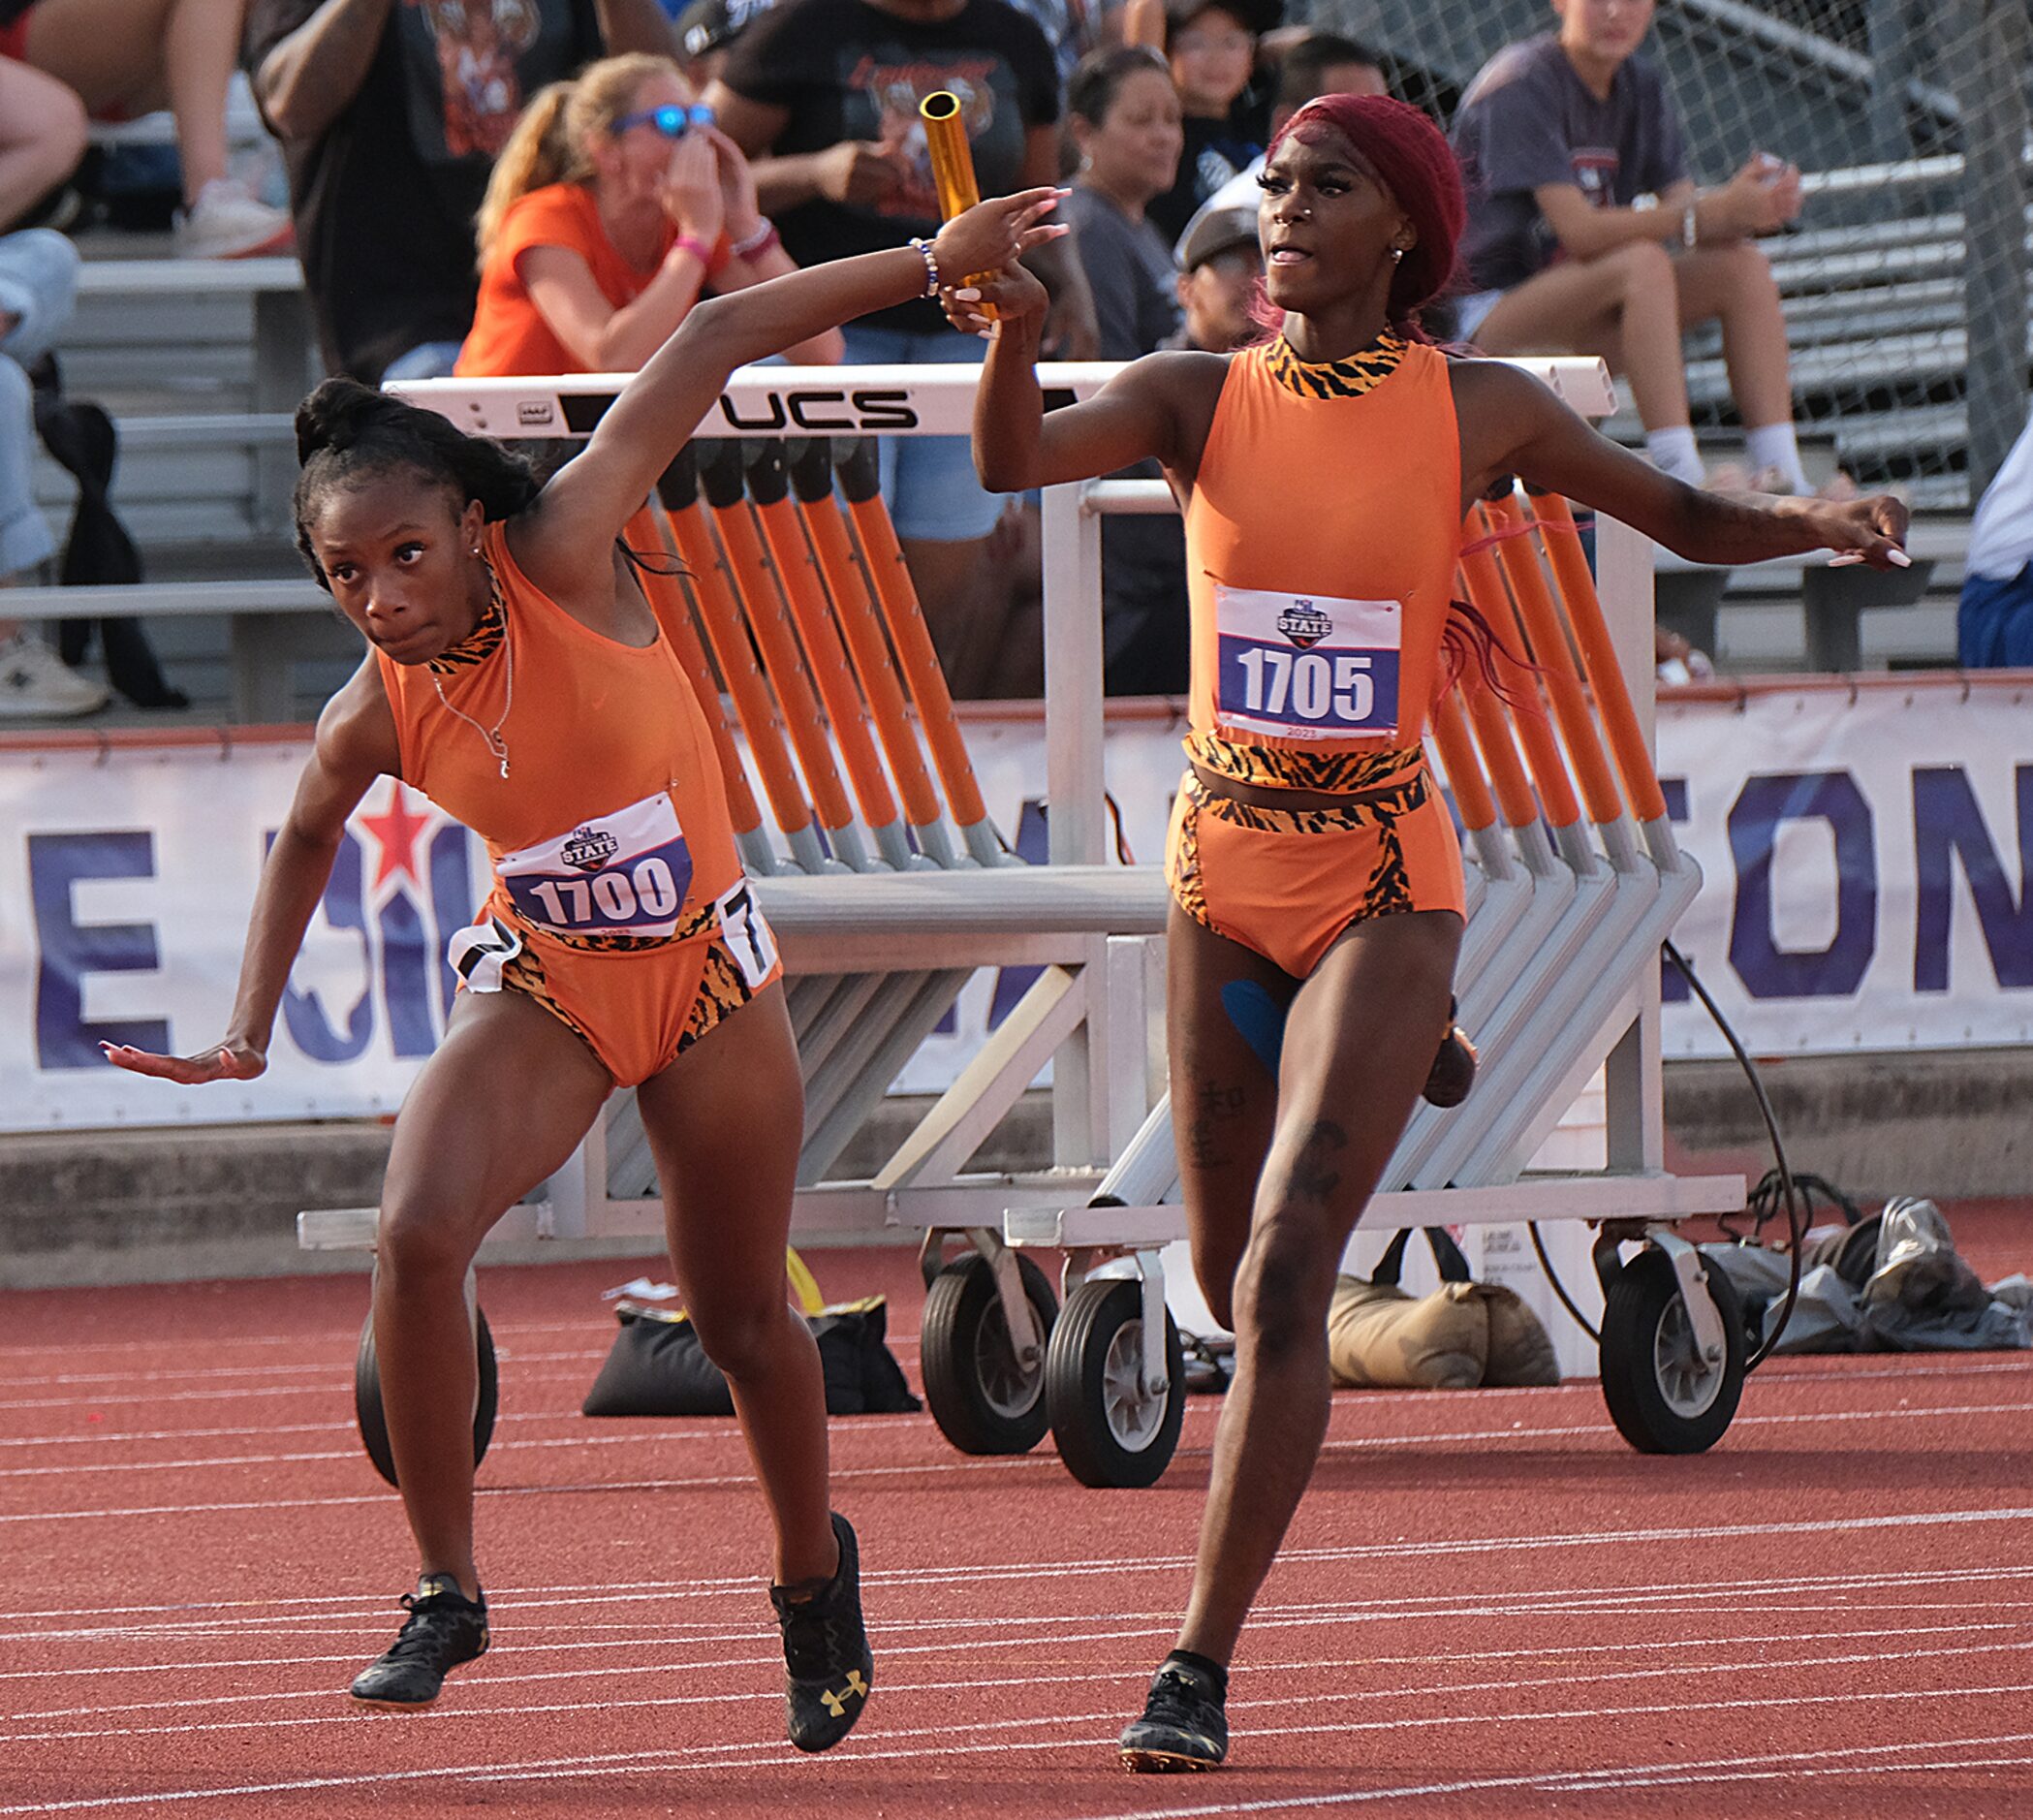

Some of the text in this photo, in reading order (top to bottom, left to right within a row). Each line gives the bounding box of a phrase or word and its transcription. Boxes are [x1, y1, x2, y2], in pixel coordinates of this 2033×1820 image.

[720, 392, 919, 429] UCS
[1278, 617, 1332, 633] STATE
[1237, 647, 1374, 721] 1705
[1287, 727, 1318, 738] 2023
[562, 838, 618, 863] STATE
[529, 858, 677, 925] 1700
[28, 831, 172, 1070] E
[724, 885, 766, 975] 7
